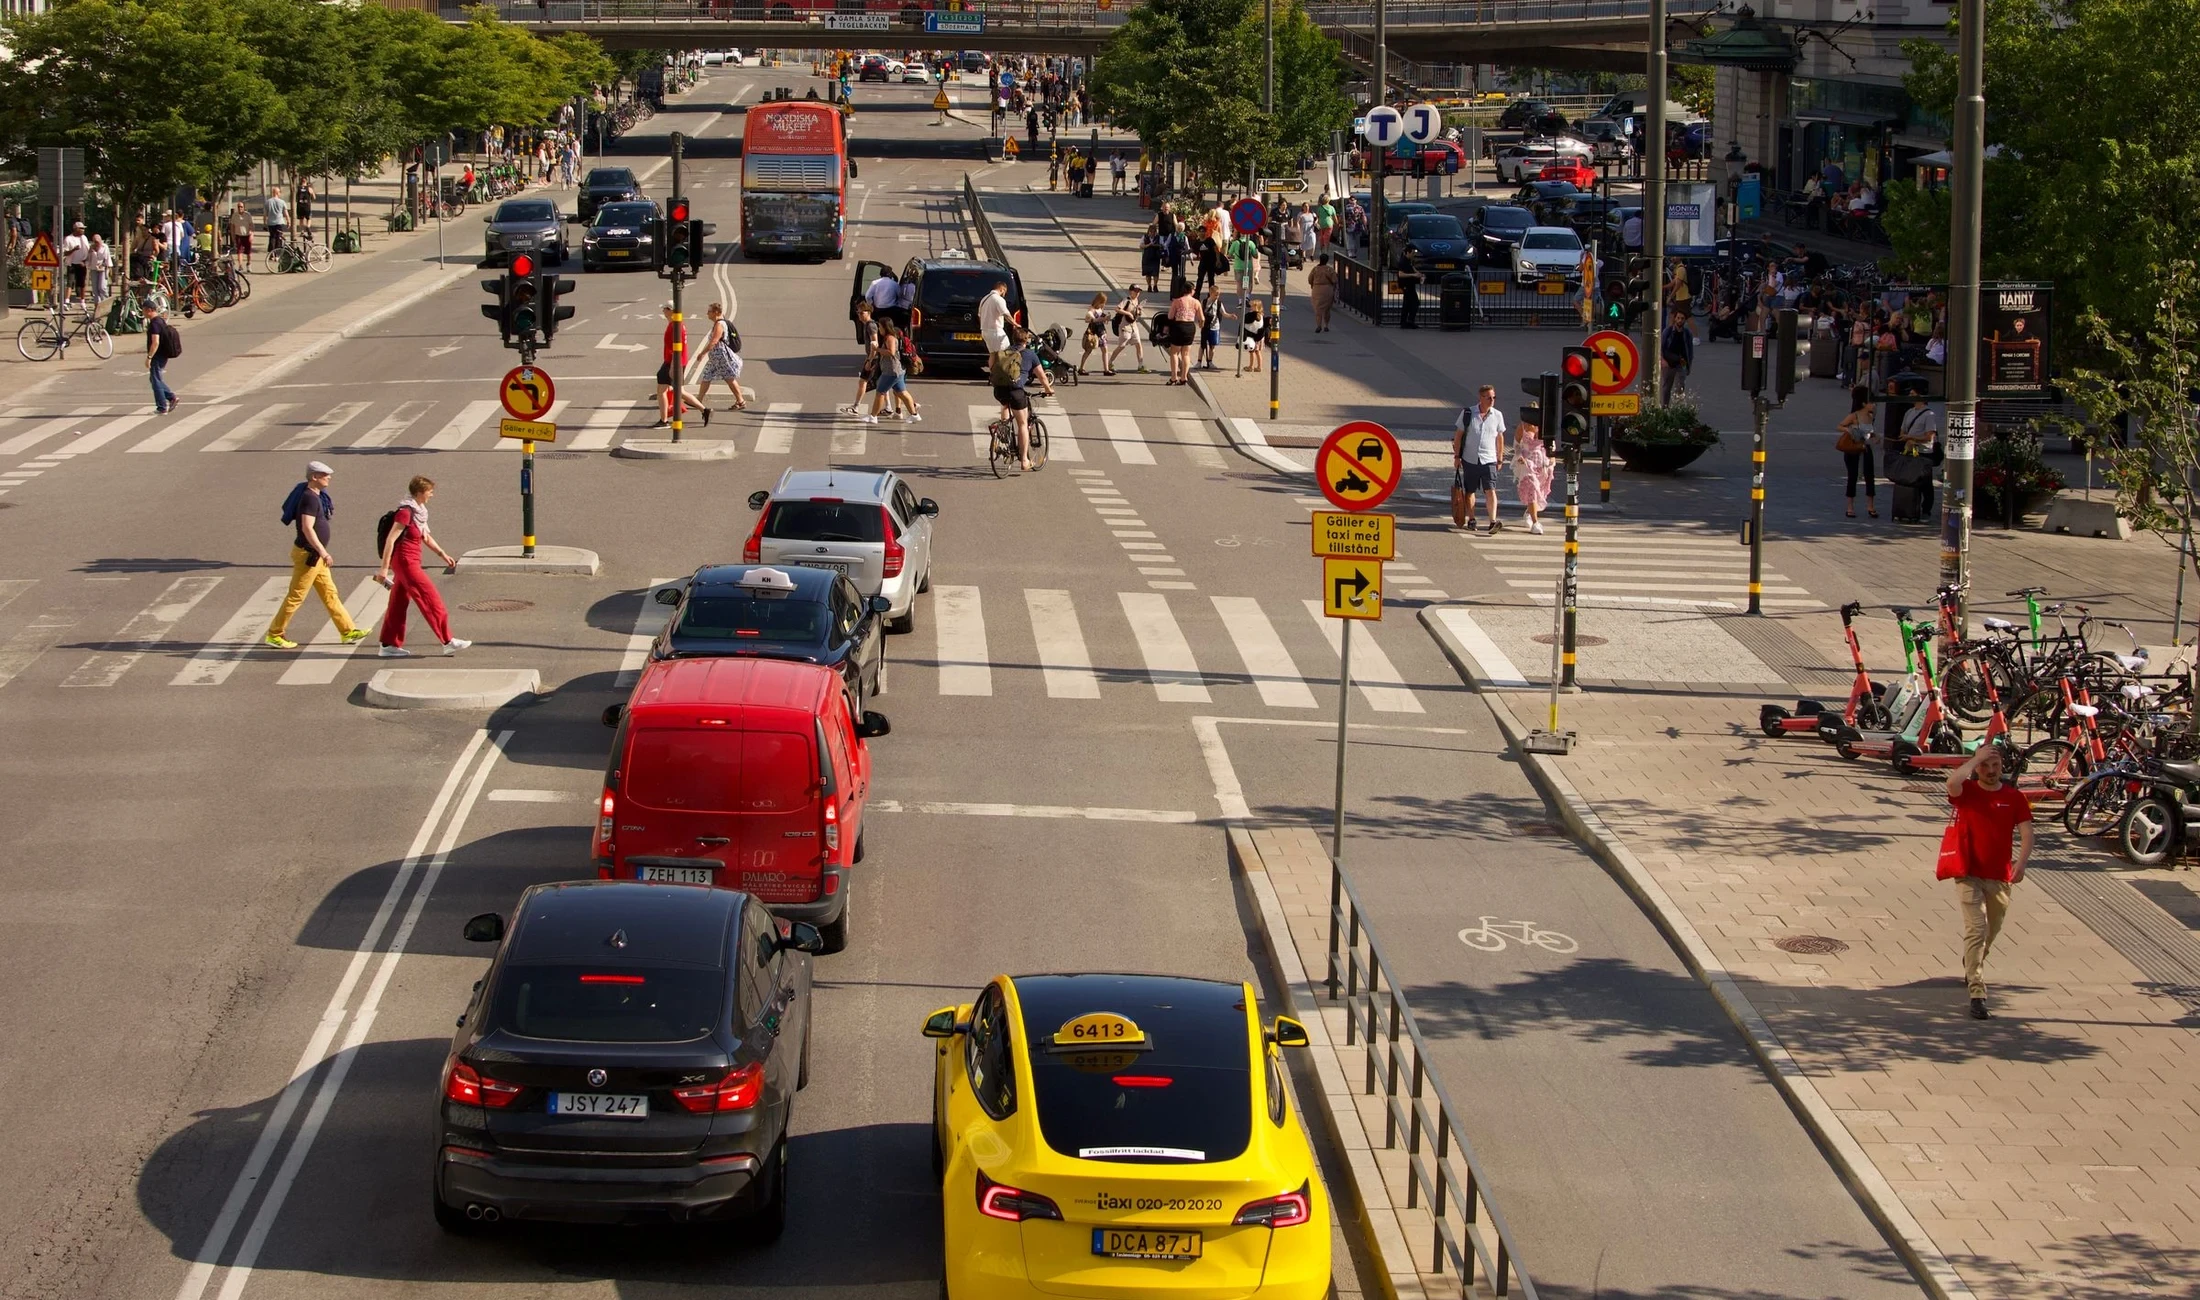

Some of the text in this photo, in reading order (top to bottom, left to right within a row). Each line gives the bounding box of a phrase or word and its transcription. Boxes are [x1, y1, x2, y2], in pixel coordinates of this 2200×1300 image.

[765, 112, 819, 123] NORDISKA
[772, 121, 813, 134] MUSEET
[1371, 114, 1396, 141] T
[1410, 109, 1430, 140] J
[1999, 291, 2035, 305] NANNY
[1949, 417, 1975, 428] FREE
[504, 424, 535, 435] Gäller ej
[1949, 428, 1974, 437] MUSIC
[1326, 516, 1380, 530] Gäller ej
[1327, 530, 1380, 541] taxi med
[1329, 542, 1379, 555] tillstånd
[649, 868, 707, 883] ZEH 113
[1073, 1023, 1124, 1037] 6413
[679, 1075, 706, 1083] X4
[565, 1096, 640, 1114] JSY 247
[1111, 1233, 1193, 1253] DCA 87J
